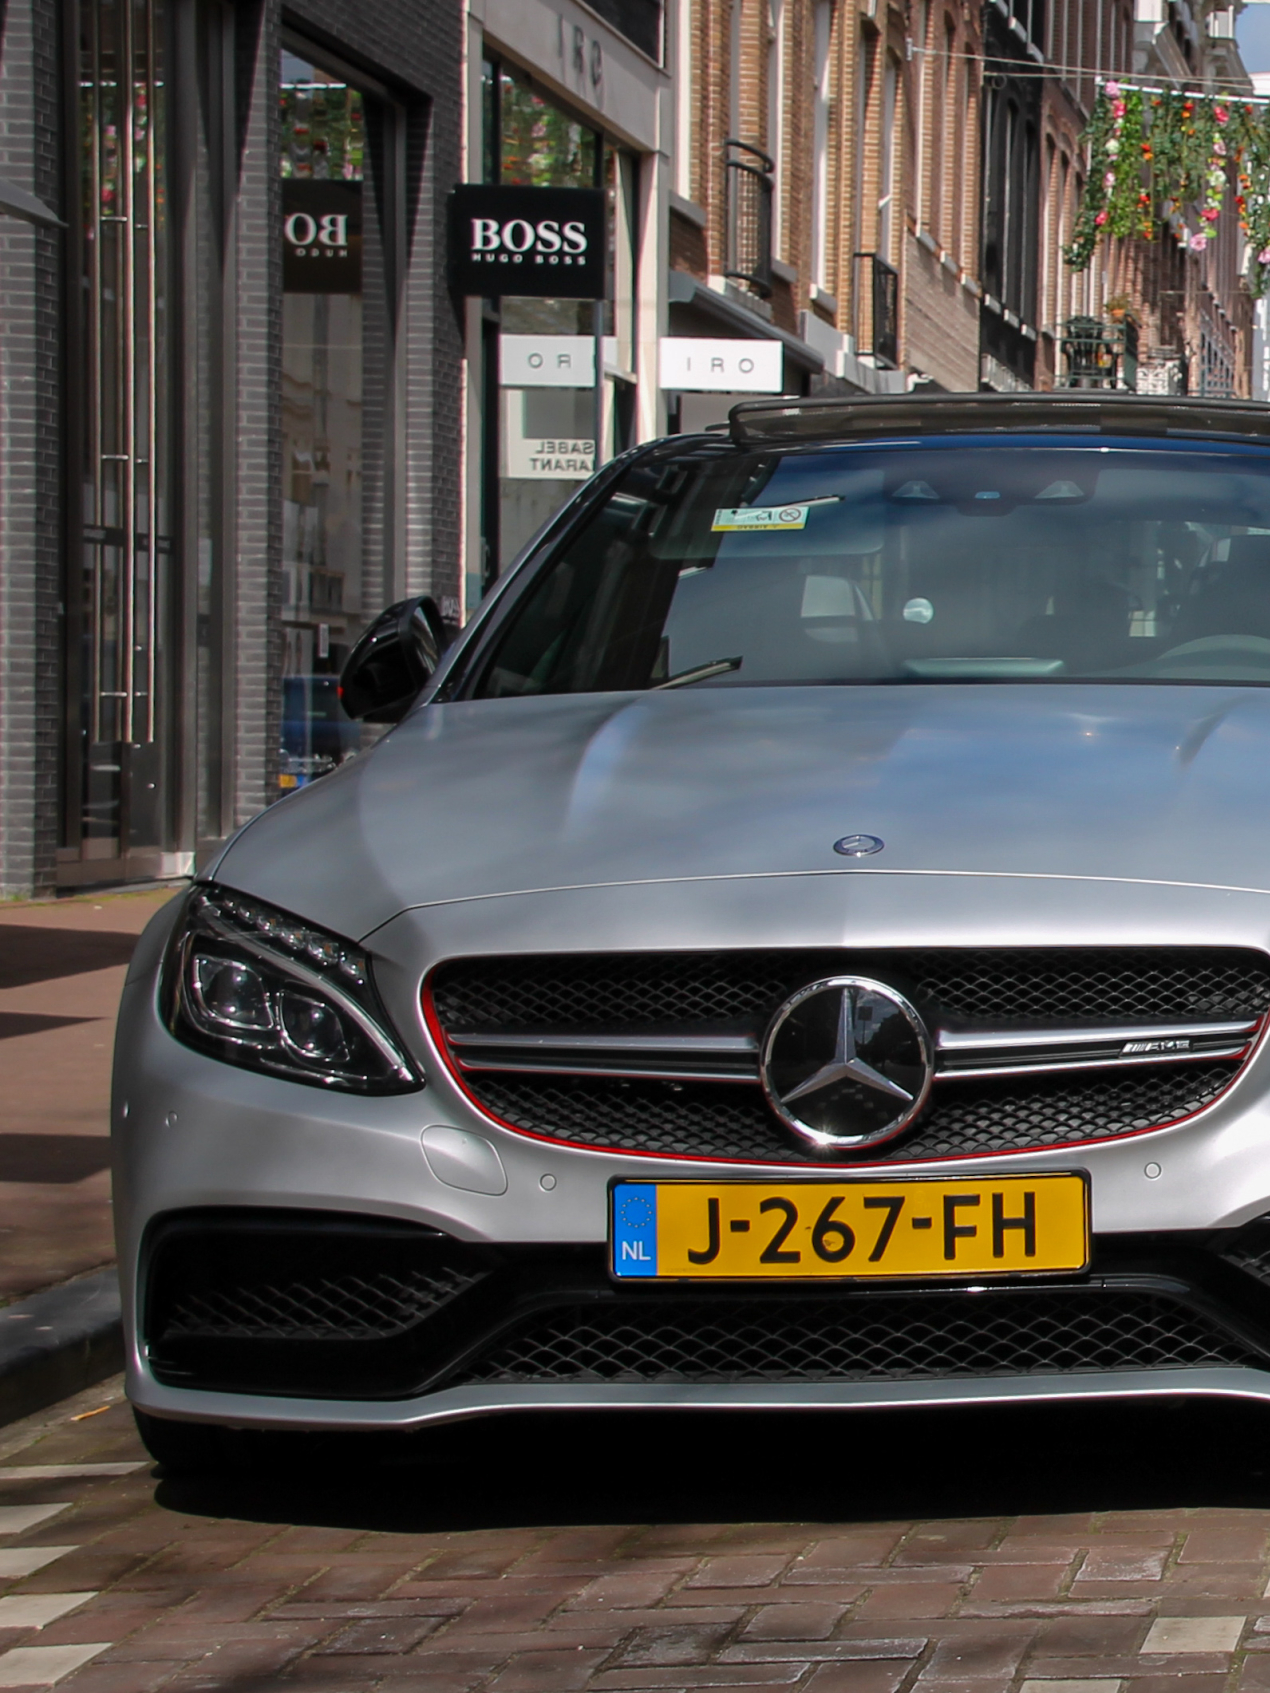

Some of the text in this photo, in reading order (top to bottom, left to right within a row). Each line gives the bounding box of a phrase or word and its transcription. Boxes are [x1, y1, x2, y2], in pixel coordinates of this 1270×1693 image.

[557, 13, 602, 87] IRO
[471, 218, 588, 254] BOSS
[471, 253, 586, 266] HUGO BOSS
[687, 357, 754, 373] IRO
[688, 1191, 1036, 1264] J-267-FH
[621, 1241, 652, 1261] NL
